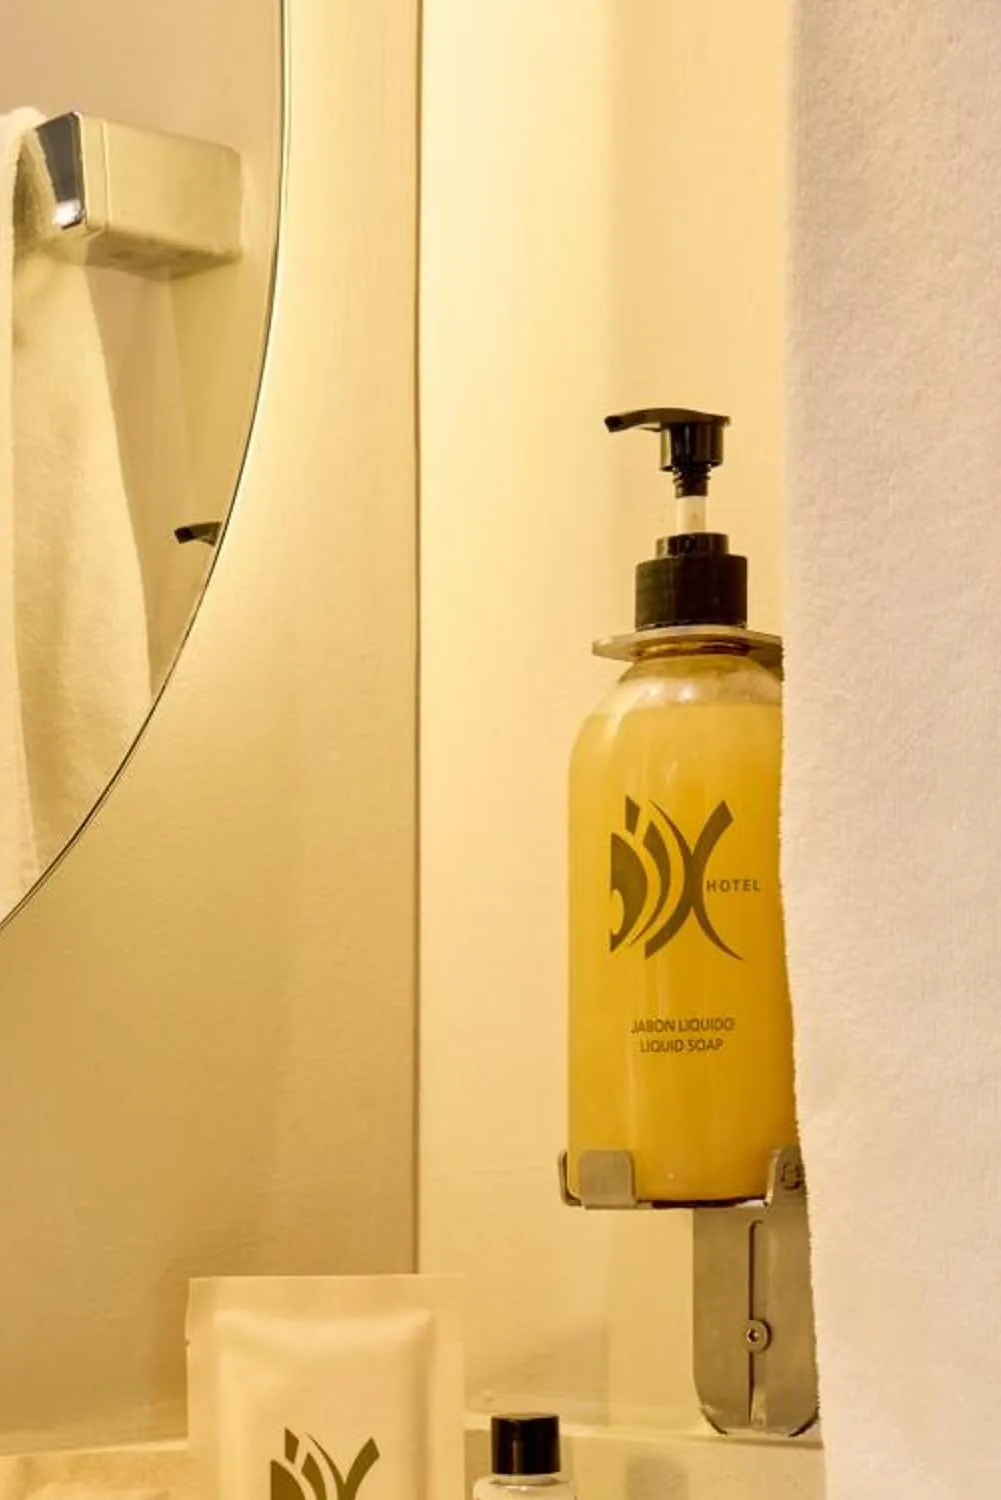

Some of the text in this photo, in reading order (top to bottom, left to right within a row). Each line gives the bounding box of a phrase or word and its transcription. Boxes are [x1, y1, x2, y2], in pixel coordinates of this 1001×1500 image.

[706, 879, 760, 892] HOTEL
[640, 1038, 724, 1053] LIQUID SOAP
